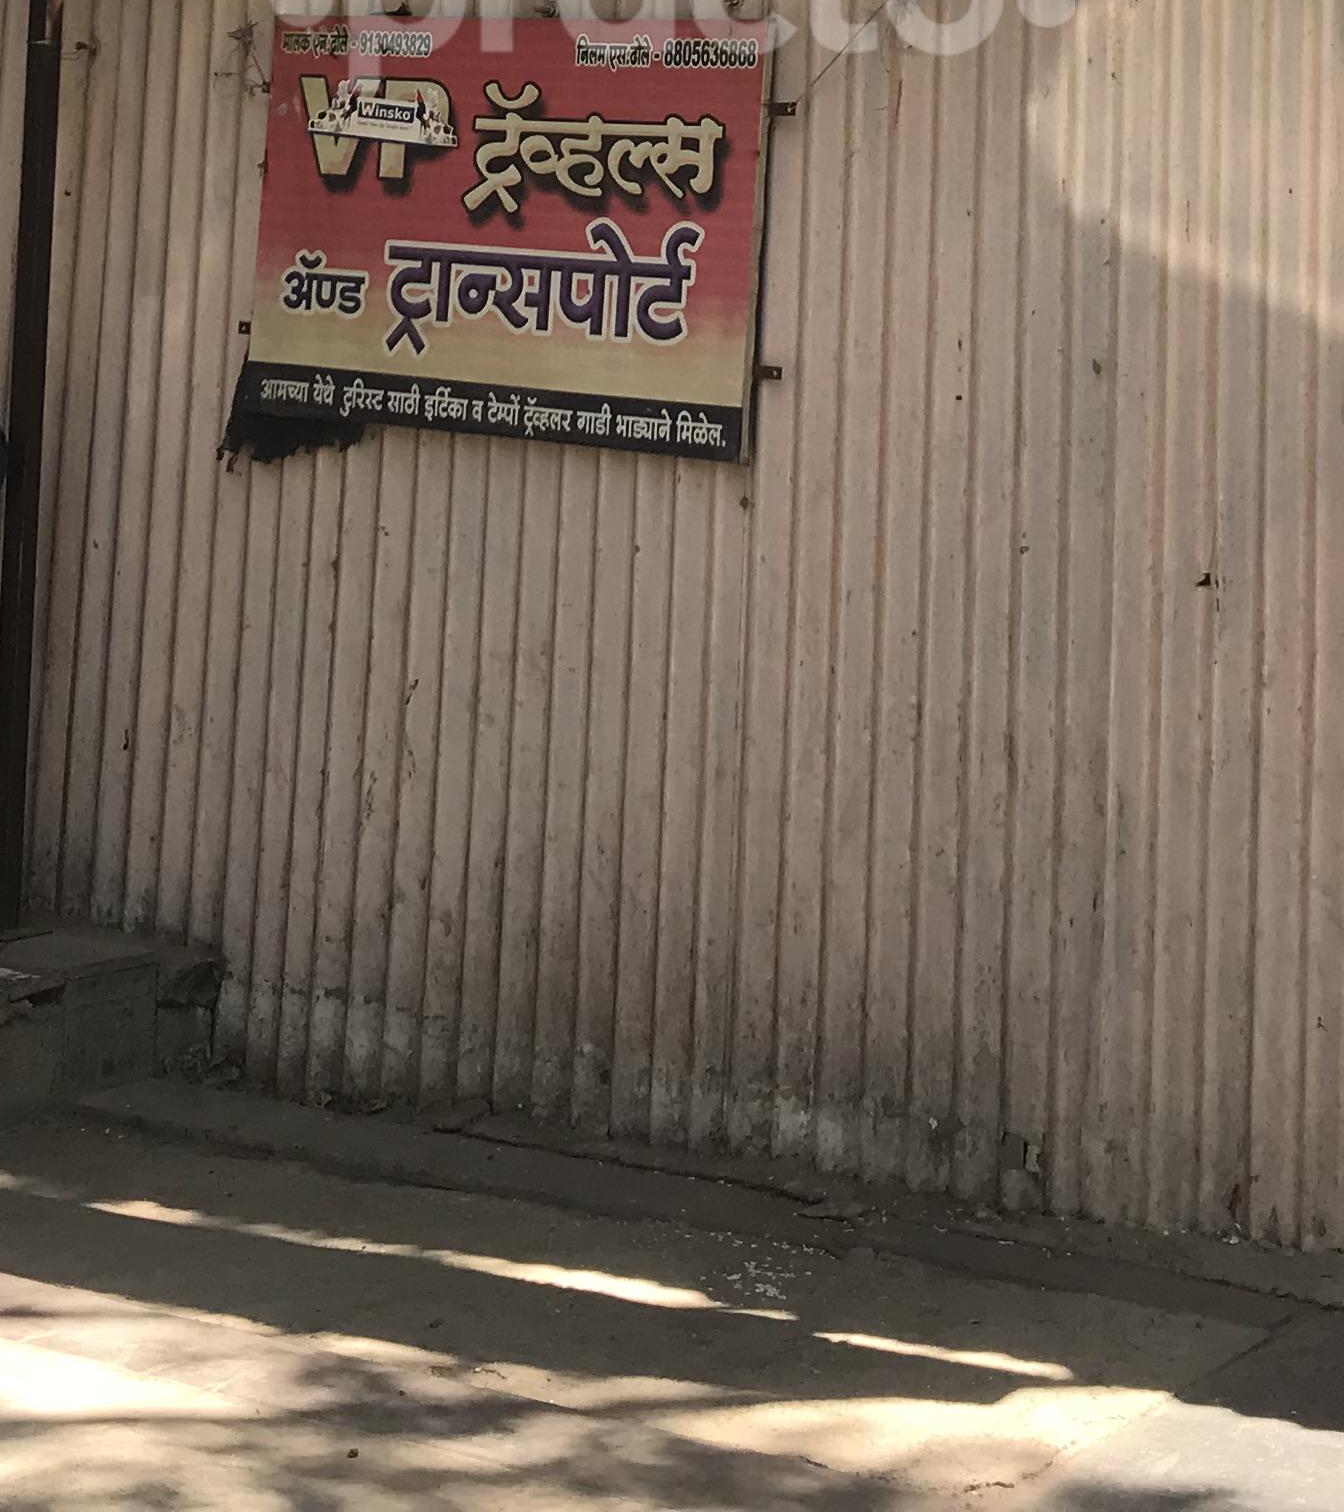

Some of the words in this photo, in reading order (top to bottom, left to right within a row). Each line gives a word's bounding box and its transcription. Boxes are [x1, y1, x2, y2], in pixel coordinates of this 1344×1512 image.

[664, 39, 758, 68] 8805636868
[362, 101, 411, 121] Winsko
[261, 378, 309, 403] आमच्या
[313, 373, 336, 406] येथे
[472, 399, 484, 422] व
